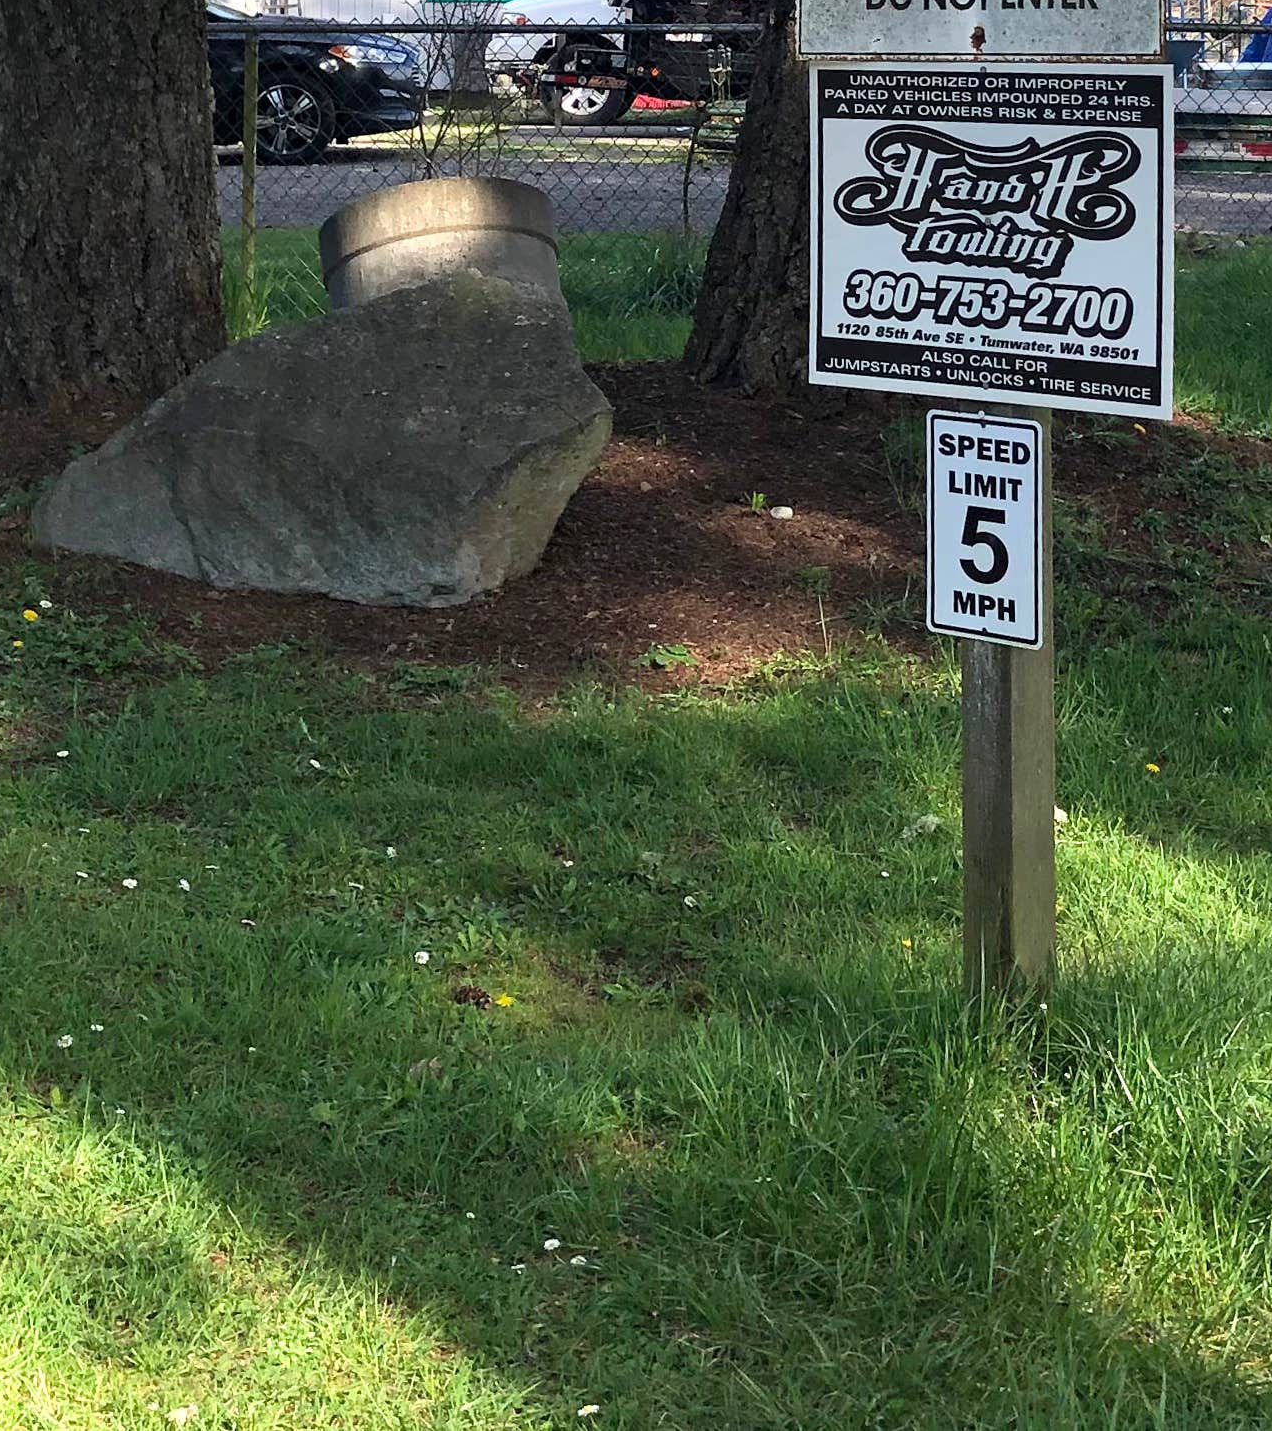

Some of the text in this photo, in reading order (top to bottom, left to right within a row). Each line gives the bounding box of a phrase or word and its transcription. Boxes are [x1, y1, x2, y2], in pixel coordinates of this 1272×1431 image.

[825, 89, 1156, 107] PARKED VEHICLES IMPOUNDED 24 HRS.
[849, 75, 1127, 90] UNAUTHORIZED OR IMPROPERLY
[836, 103, 1142, 122] A DAY AT OWNERS RISK & EXPENSE
[941, 172, 1026, 212] and
[904, 217, 1065, 270] Towing
[845, 271, 1131, 336] 360-753-2700
[836, 323, 1139, 361] 1120 85th Ave SE Tumwater, WA 98501
[921, 350, 1048, 373] ALSO CALL FOR
[824, 357, 1152, 400] JUMPSTARTS UNLOCKS TIRE SERVICE
[938, 433, 1031, 465] SPEED
[948, 470, 1023, 502] LIMIT
[959, 505, 1009, 585] 5
[953, 590, 1016, 623] MPH
